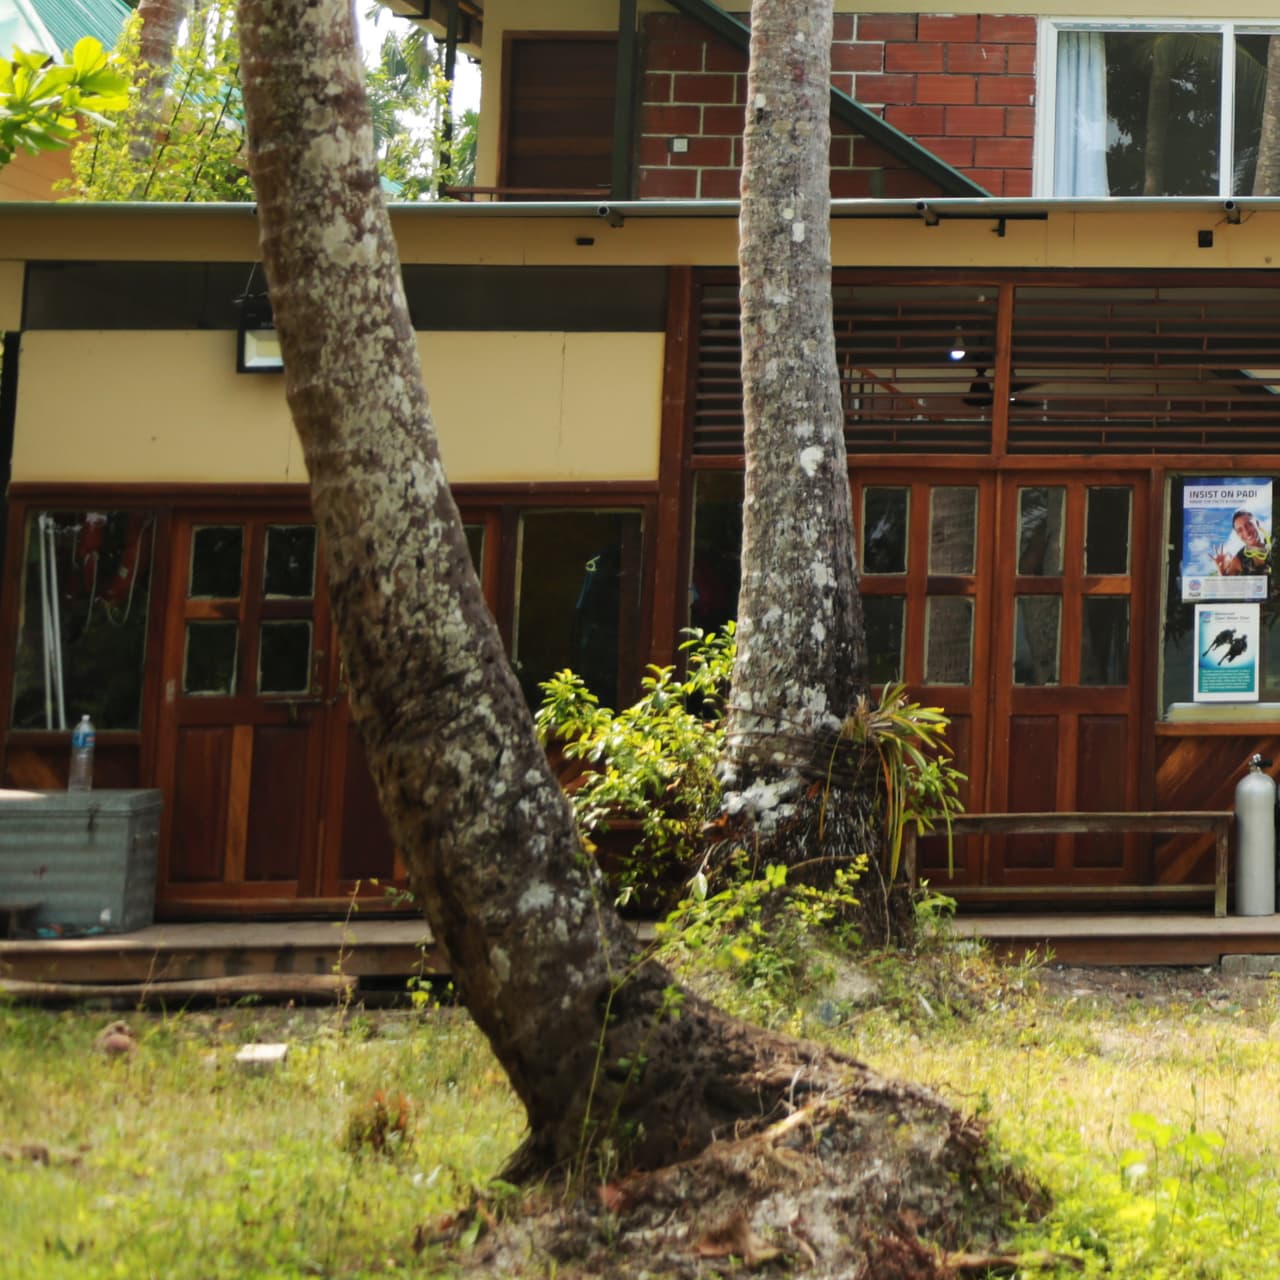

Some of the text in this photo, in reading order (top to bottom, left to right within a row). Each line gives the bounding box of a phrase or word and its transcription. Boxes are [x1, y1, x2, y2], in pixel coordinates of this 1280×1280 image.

[1189, 489, 1258, 499] INSIST ON PADI
